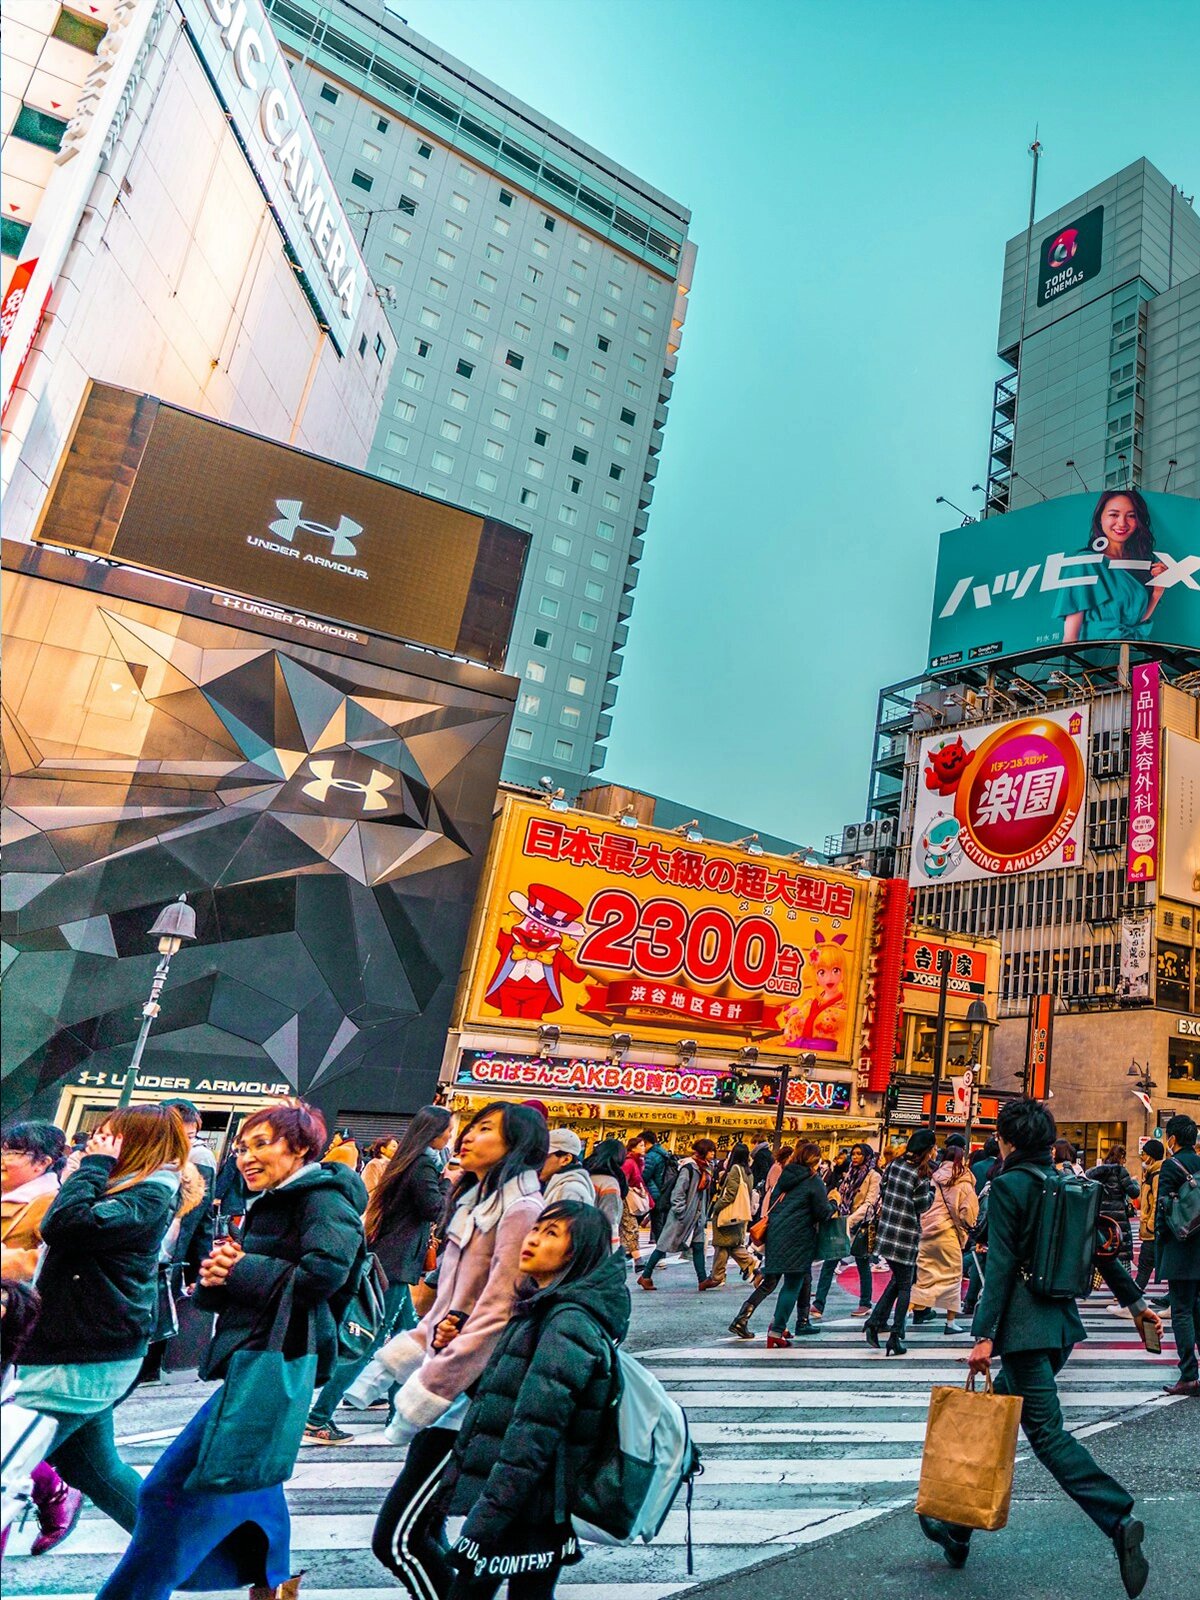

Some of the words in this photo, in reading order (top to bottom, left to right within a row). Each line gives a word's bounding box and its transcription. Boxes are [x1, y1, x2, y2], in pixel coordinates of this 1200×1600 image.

[260, 86, 357, 320] CAMERA
[1044, 271, 1084, 299] CINEMAS
[1045, 267, 1074, 289] TOHO
[247, 535, 300, 559] UNDER
[242, 604, 293, 624] UNDER
[1070, 718, 1081, 727] 40
[1134, 691, 1154, 814] 品川美容外科
[973, 765, 1065, 828] 楽園
[958, 825, 1000, 872] EXCITING
[1004, 808, 1077, 872] AMUSEMENT
[1064, 844, 1075, 854] 30
[522, 817, 855, 920] 日本最大級の超大型店
[767, 978, 799, 994] OVER
[913, 973, 971, 992] YOSHOYA
[630, 985, 743, 1020] 渋谷地区合計
[111, 1073, 190, 1090] UNDER
[195, 1079, 290, 1095] ARMOUR
[652, 1112, 678, 1120] STAGE
[744, 1118, 768, 1126] STAGE
